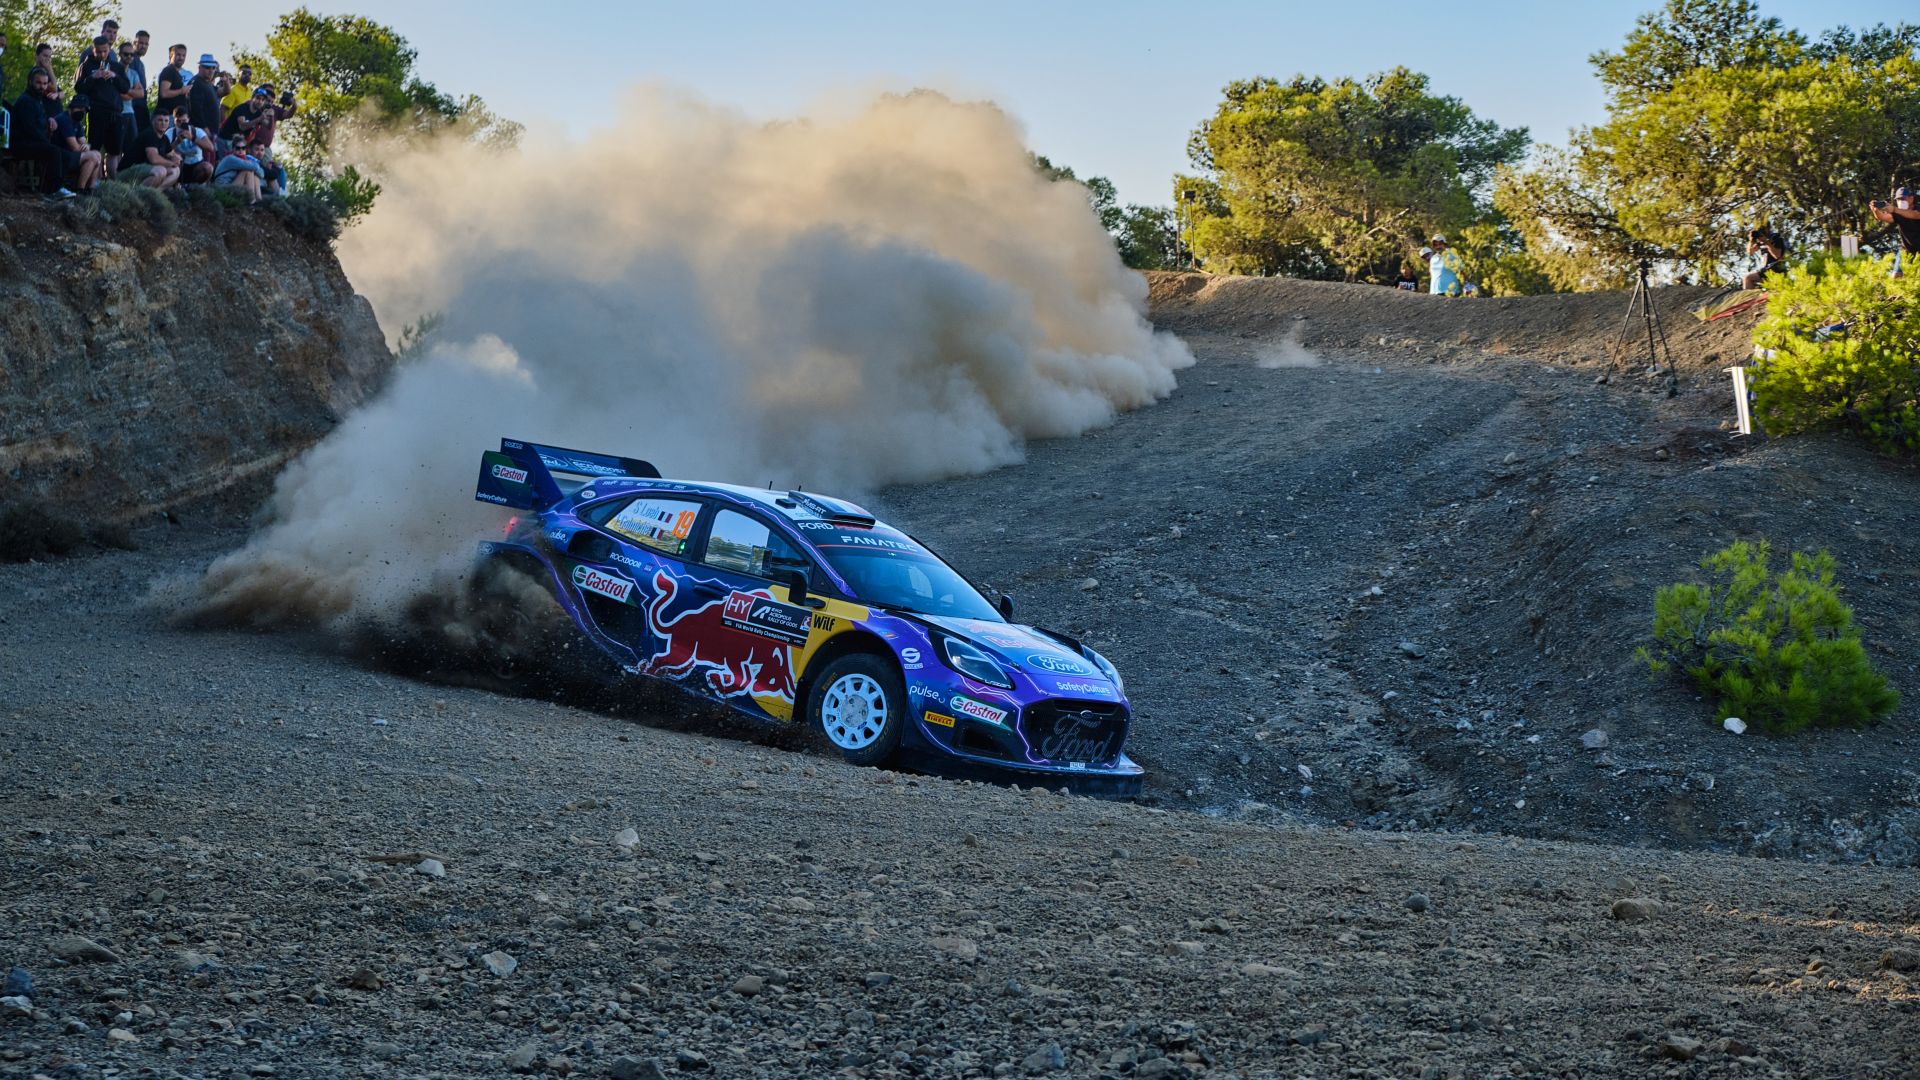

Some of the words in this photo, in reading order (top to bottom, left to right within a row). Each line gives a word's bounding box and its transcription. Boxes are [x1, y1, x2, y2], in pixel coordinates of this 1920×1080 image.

[501, 467, 525, 482] Castrol
[477, 492, 508, 503] SafetyCulture
[671, 510, 696, 539] 19
[841, 536, 918, 552] FANATEC
[610, 552, 642, 568] ROCKDOOR
[586, 572, 628, 599] Castrol
[727, 598, 750, 614] HY
[769, 611, 792, 621] ACROPOLIS
[764, 630, 790, 642] Championship
[1038, 655, 1085, 673] Ford
[909, 685, 939, 700] pulse
[1056, 682, 1110, 694] SafetyCulture
[963, 700, 1002, 723] Castrol
[1042, 714, 1114, 762] Ford
